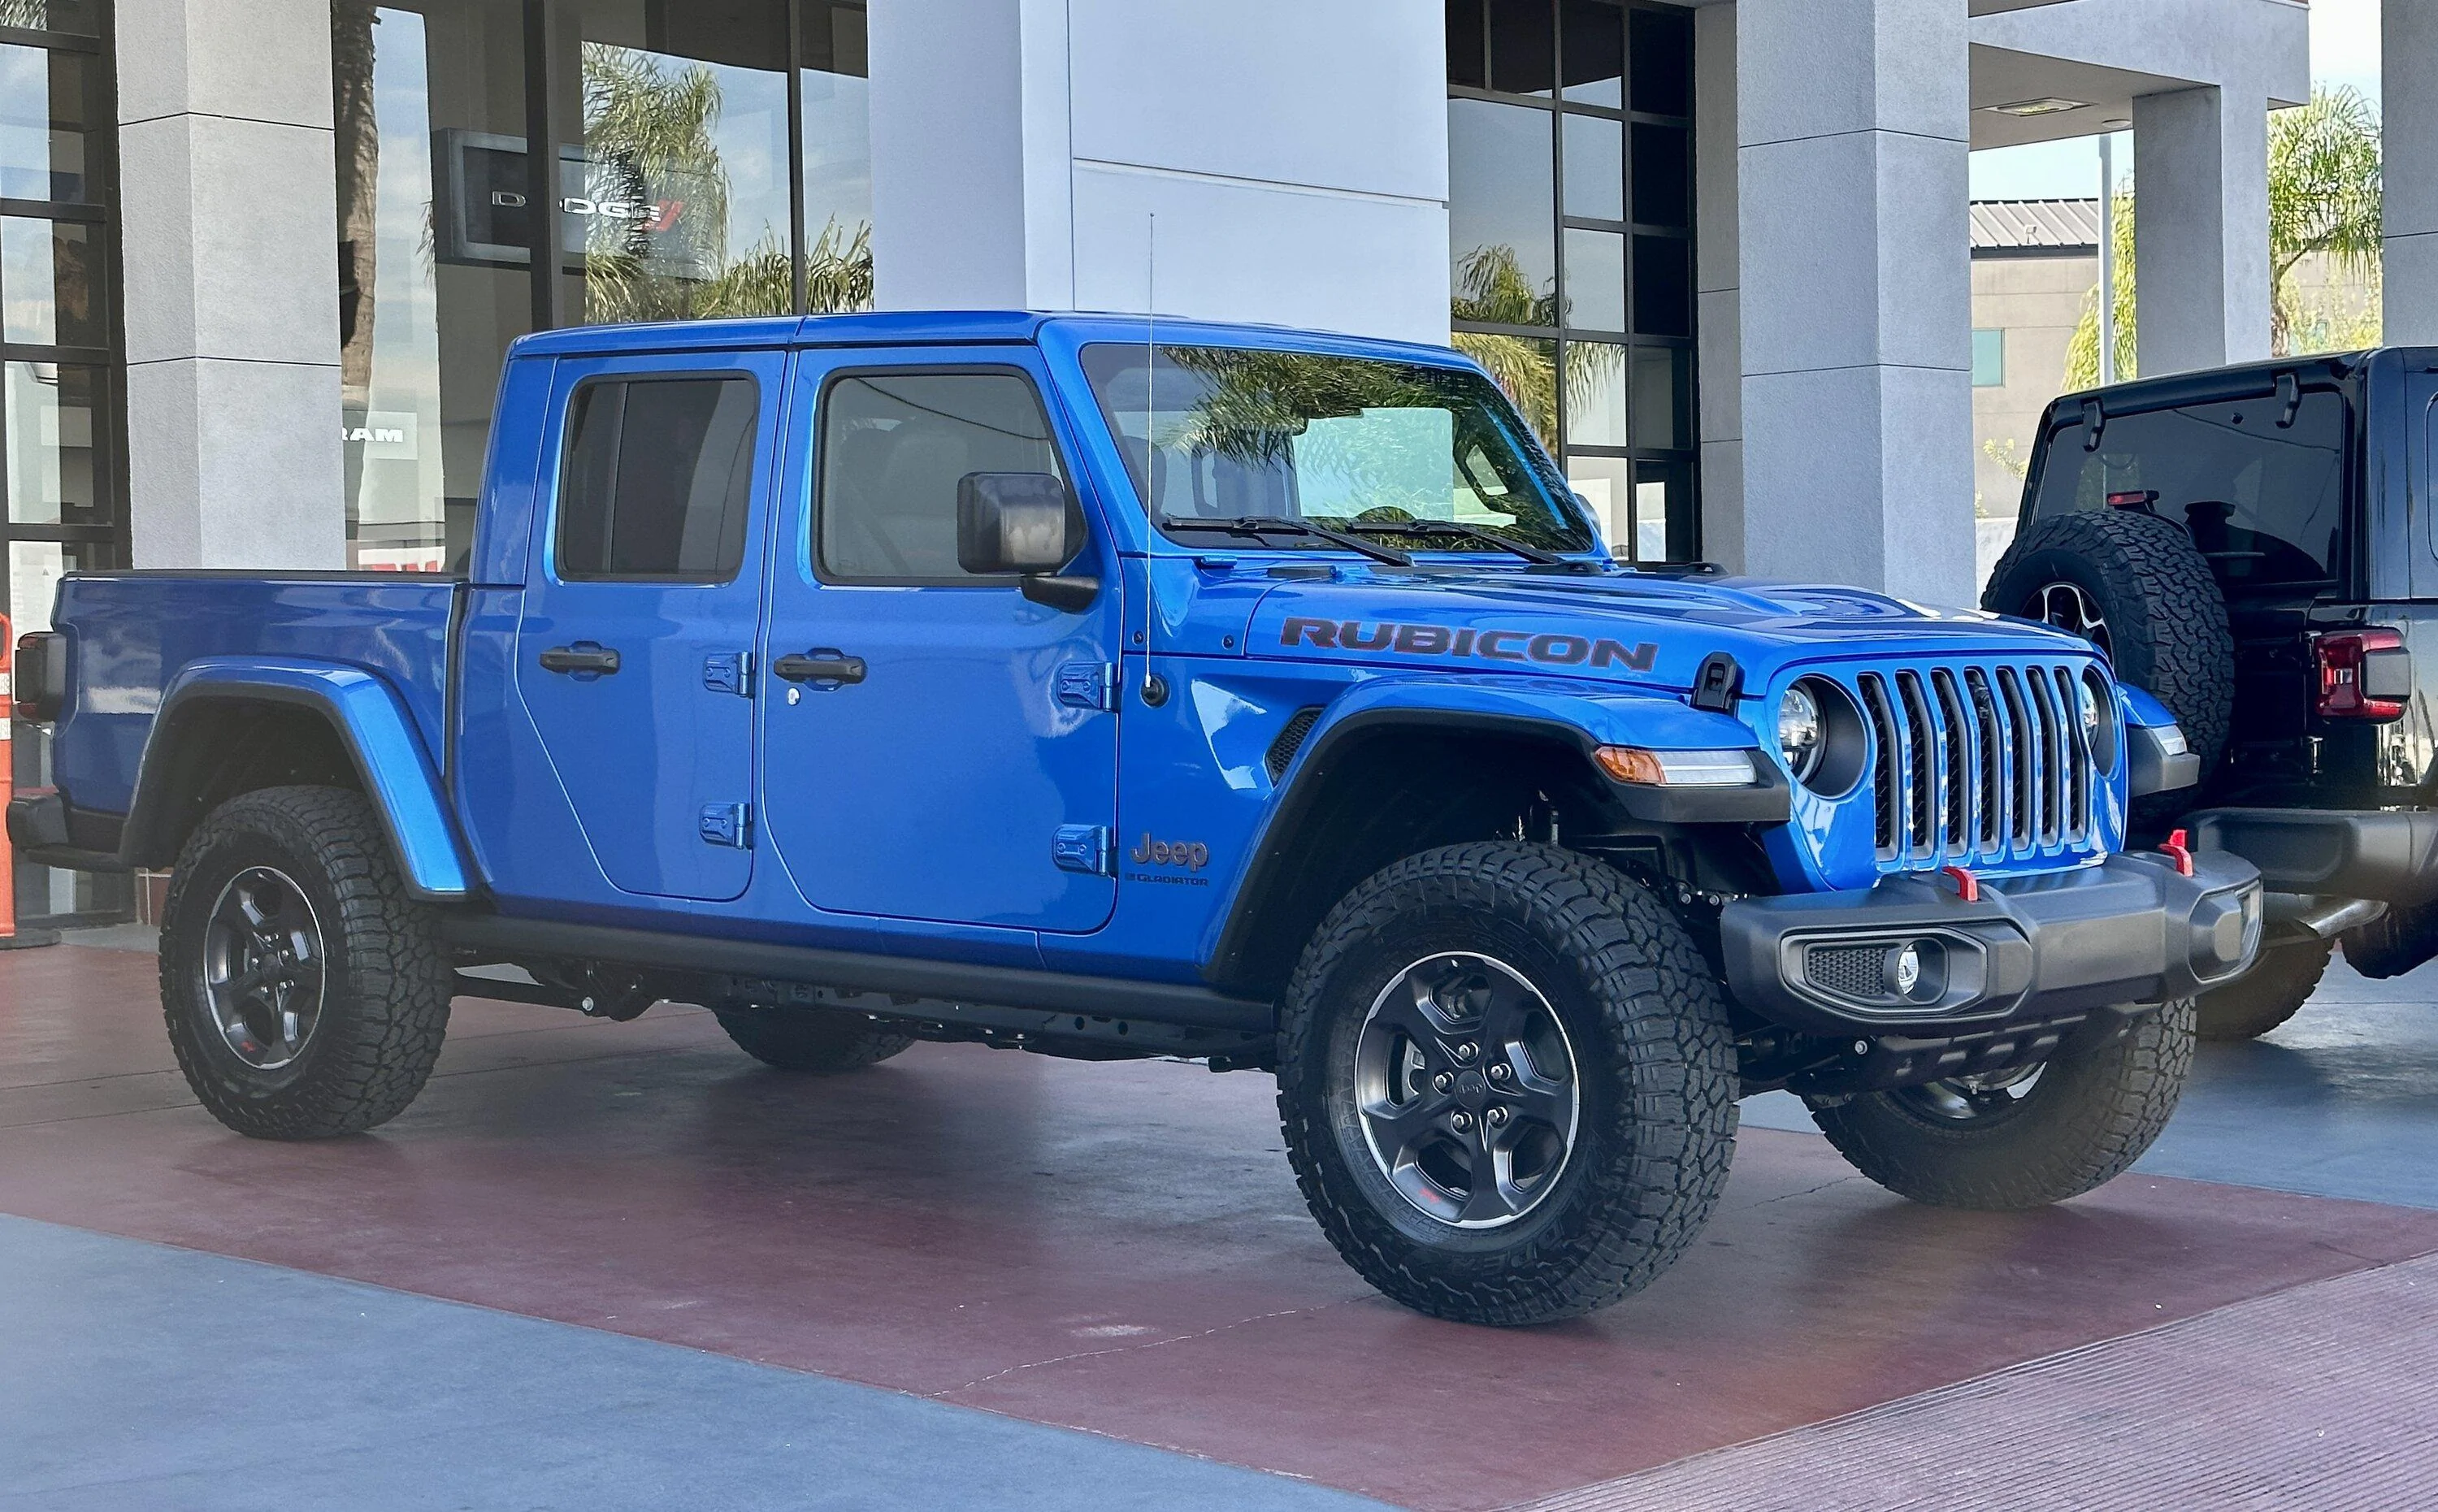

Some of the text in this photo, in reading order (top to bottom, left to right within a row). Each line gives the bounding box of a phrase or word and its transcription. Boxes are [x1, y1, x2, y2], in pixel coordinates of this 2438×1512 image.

[492, 191, 662, 222] DDGE
[1280, 617, 1659, 672] RUBICON
[1130, 831, 1208, 873] Jeep
[1137, 873, 1209, 887] GLADIATOR
